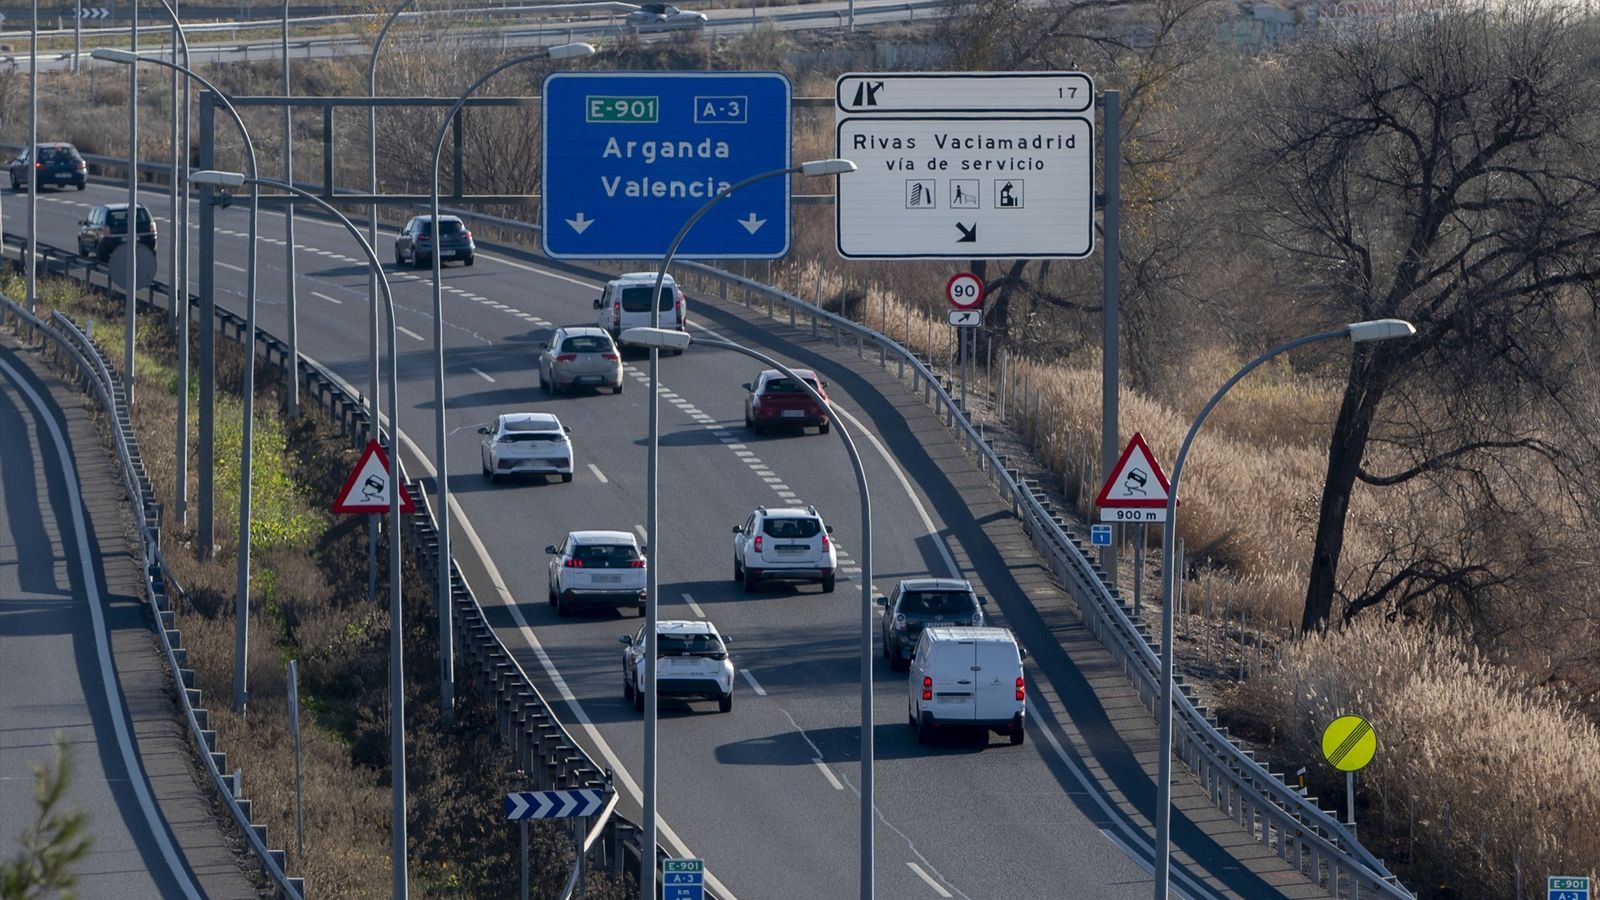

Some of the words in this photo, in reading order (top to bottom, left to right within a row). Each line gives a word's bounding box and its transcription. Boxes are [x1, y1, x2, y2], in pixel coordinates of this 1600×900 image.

[1058, 87, 1078, 99] 17
[591, 100, 654, 118] E-901
[702, 101, 740, 117] A-3
[853, 134, 917, 150] Rivas
[934, 133, 1076, 150] Vaciamadrid
[602, 136, 730, 164] Arganda
[886, 156, 915, 171] vía
[927, 157, 949, 171] de
[961, 157, 1045, 171] servicio
[601, 176, 732, 198] Valencia
[954, 284, 976, 298] 90
[1116, 510, 1142, 520] 900
[1146, 512, 1157, 520] m
[669, 862, 699, 870] E-901
[673, 874, 694, 883] A-3
[1553, 880, 1584, 889] E-901
[1558, 892, 1579, 900] A-3
